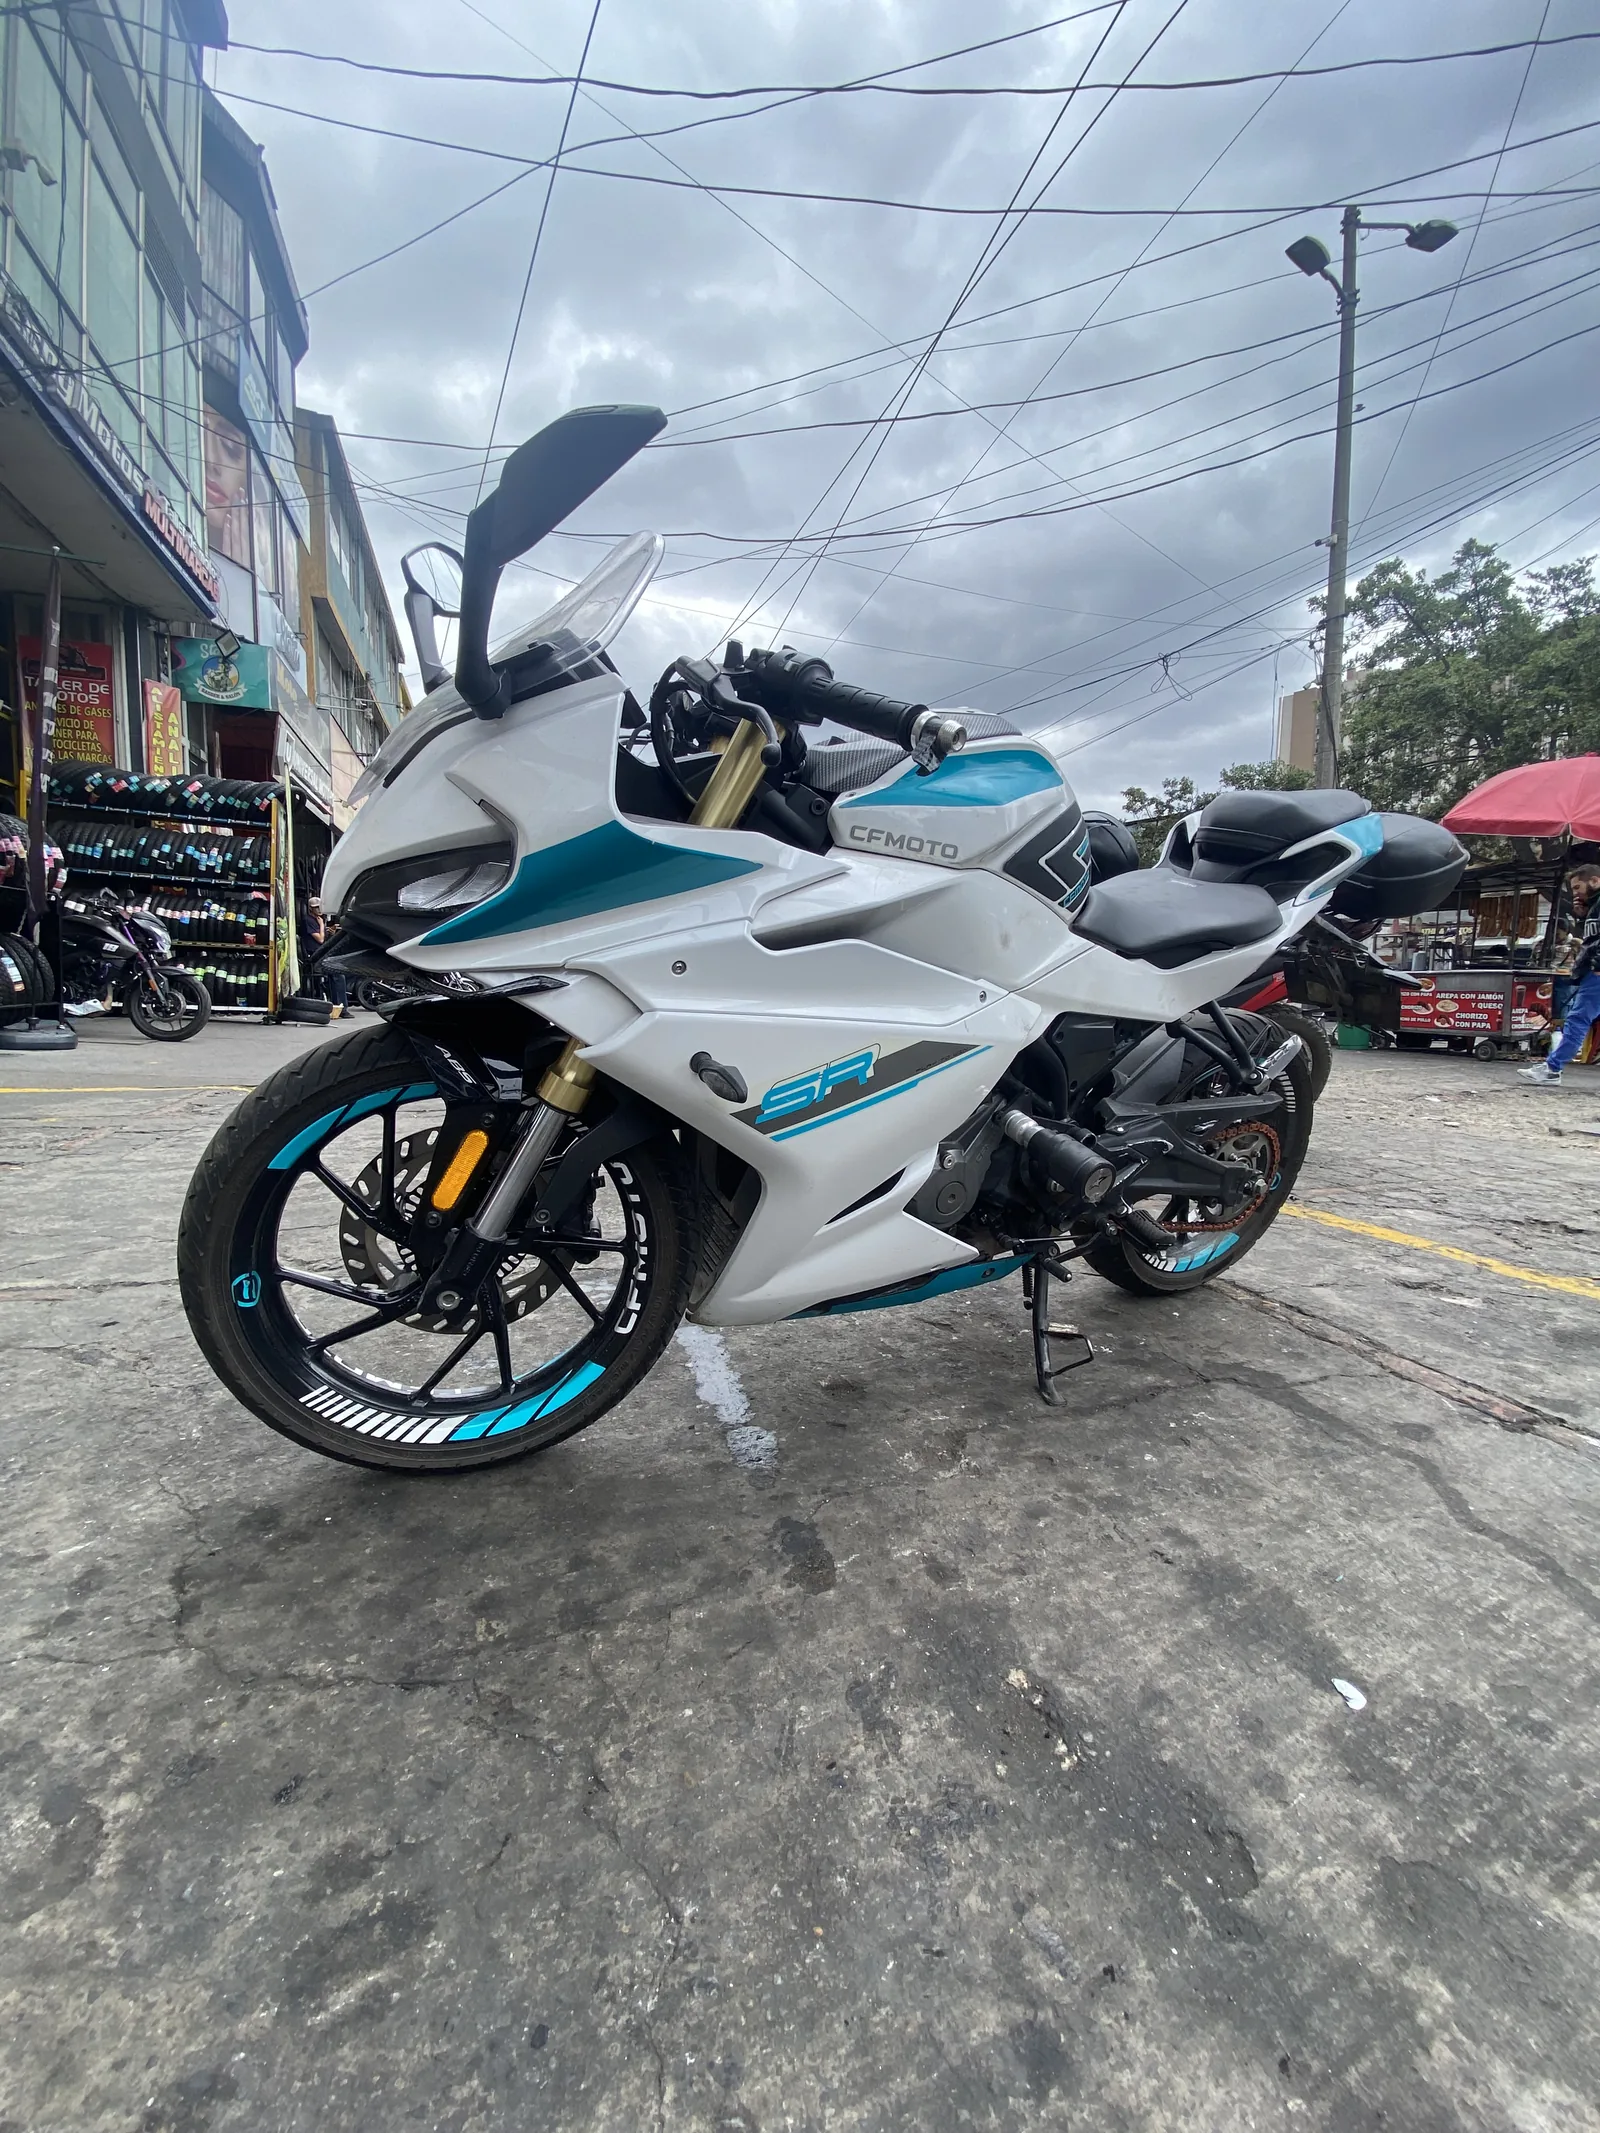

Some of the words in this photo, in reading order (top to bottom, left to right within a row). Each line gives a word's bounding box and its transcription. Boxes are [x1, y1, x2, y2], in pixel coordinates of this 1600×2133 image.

[145, 489, 219, 603] MULTIMARCAS
[89, 682, 110, 695] DE
[56, 690, 100, 705] OTOS
[70, 704, 82, 716] DE
[84, 706, 112, 718] GASES
[83, 719, 95, 730] DE
[76, 730, 99, 741] PARA
[76, 752, 112, 764] MARCAS
[849, 824, 959, 860] CFMOTO
[1477, 992, 1504, 1000] JAMÓN
[1477, 1002, 1504, 1010] QUESO
[1455, 1012, 1489, 1020] CHORIZO
[1471, 1021, 1491, 1029] PAPA
[434, 1044, 477, 1085] ABS
[755, 1049, 877, 1125] SR
